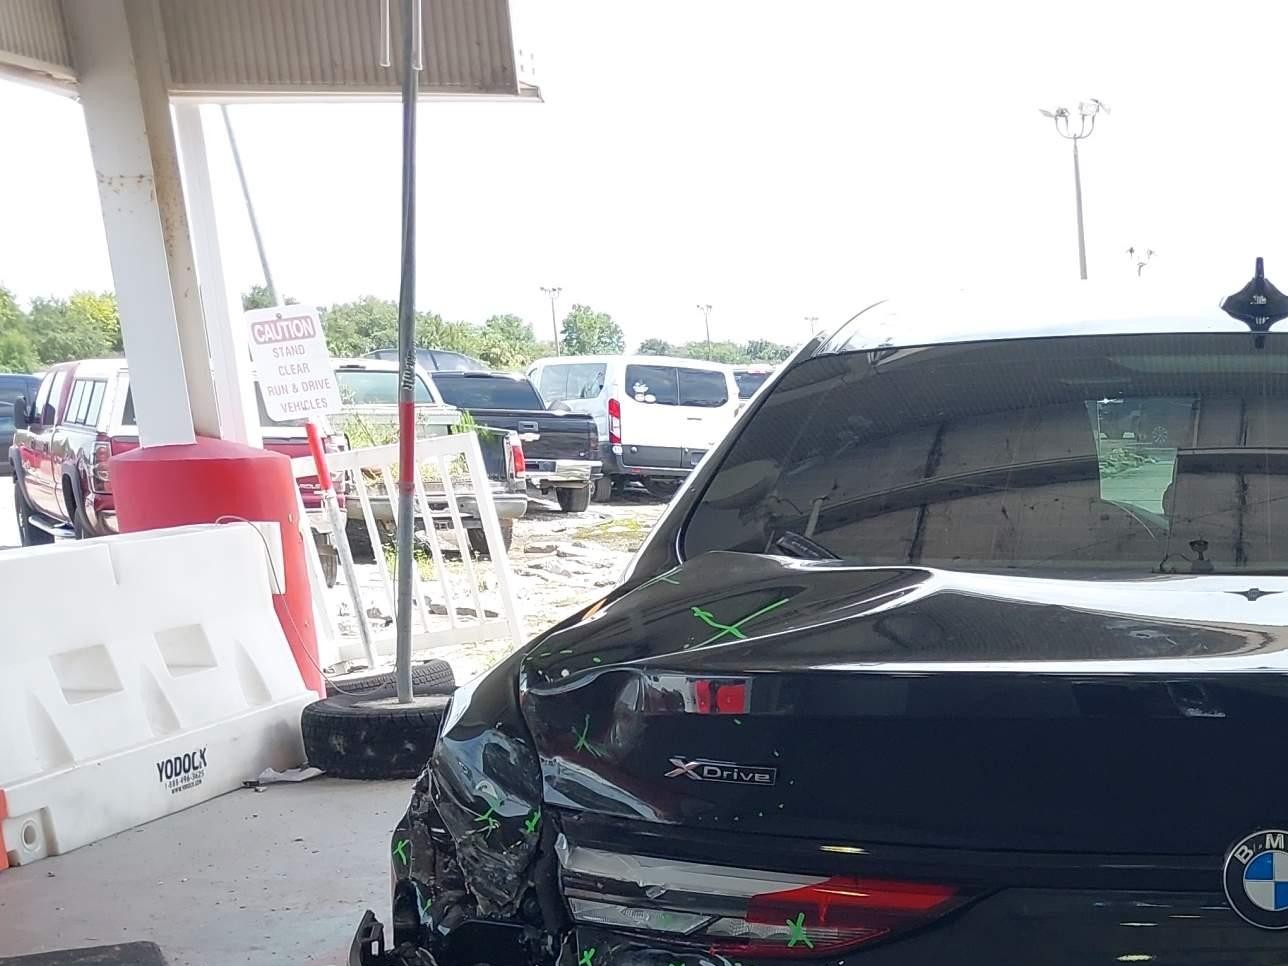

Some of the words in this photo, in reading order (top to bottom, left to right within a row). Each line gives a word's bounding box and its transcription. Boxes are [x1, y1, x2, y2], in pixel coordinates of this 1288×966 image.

[253, 319, 314, 342] CAUTION
[272, 344, 305, 358] STAND
[278, 362, 310, 376] CLEAR
[267, 384, 289, 397] RUN
[292, 382, 299, 394] &
[301, 378, 331, 392] DRIVE
[280, 398, 328, 413] VEHICLES
[157, 747, 207, 782] YODOCK
